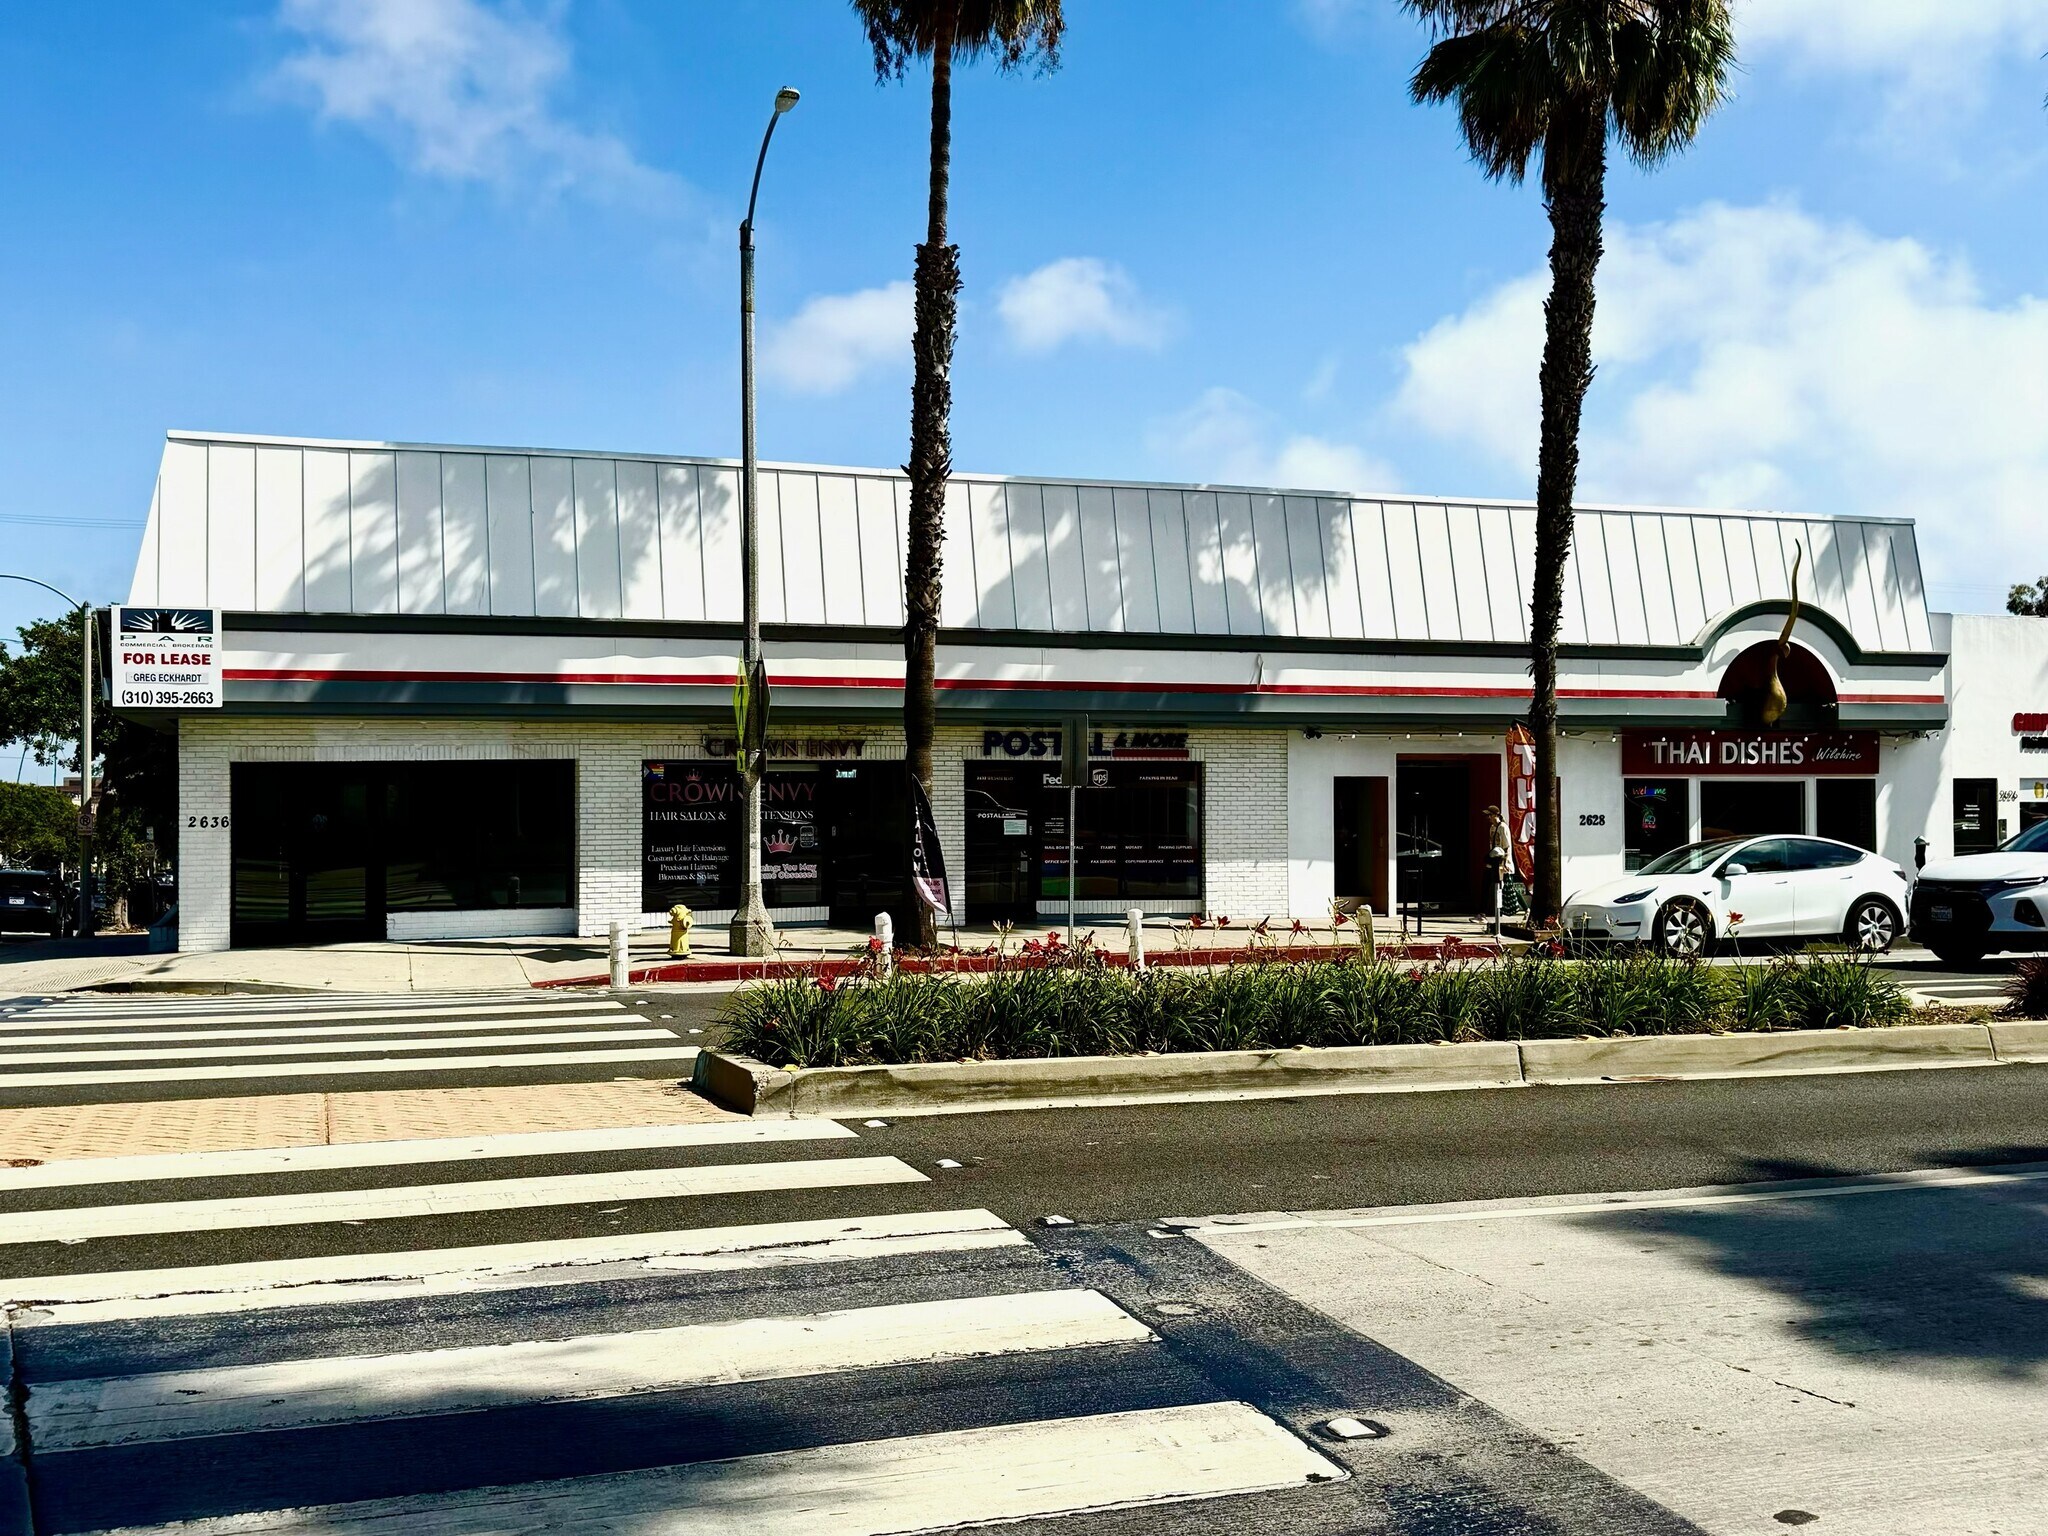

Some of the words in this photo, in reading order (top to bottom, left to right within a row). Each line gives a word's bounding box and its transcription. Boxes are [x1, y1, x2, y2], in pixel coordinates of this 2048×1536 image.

[123, 653, 156, 665] FOR
[161, 653, 212, 665] LEASE
[133, 673, 157, 682] GREG
[158, 673, 202, 682] ECKHARDT
[121, 690, 154, 705] (310)
[155, 692, 214, 704] 395-2663
[705, 739, 798, 757] CRWN
[806, 740, 866, 757] ENVY
[984, 731, 1112, 756] POSTL
[1130, 732, 1189, 748] MORE
[1651, 741, 1711, 764] THAI
[1718, 741, 1805, 764] DISHES
[1815, 747, 1862, 761] Wilshire
[1042, 774, 1063, 785] Fed
[1632, 786, 1667, 796] welme
[1513, 743, 1537, 863] THA
[650, 811, 677, 821] HAIR
[680, 811, 716, 821] SALON
[717, 811, 728, 821] &
[760, 810, 814, 820] TENSIONS
[1579, 814, 1606, 826] 2628
[188, 816, 230, 828] 2636
[651, 845, 675, 854] Luxury
[676, 844, 691, 852] Hair
[692, 844, 726, 852] Extensions
[647, 854, 674, 862] Custom
[674, 854, 693, 862] Color
[693, 854, 701, 862] &
[701, 853, 730, 863] Balayage
[660, 863, 689, 871] Precision
[690, 863, 718, 871] Haircuts
[782, 863, 798, 872] You
[799, 863, 817, 873] May
[658, 873, 688, 881] Blowouts
[696, 873, 720, 882] Styling
[778, 870, 818, 879] Obsessed
